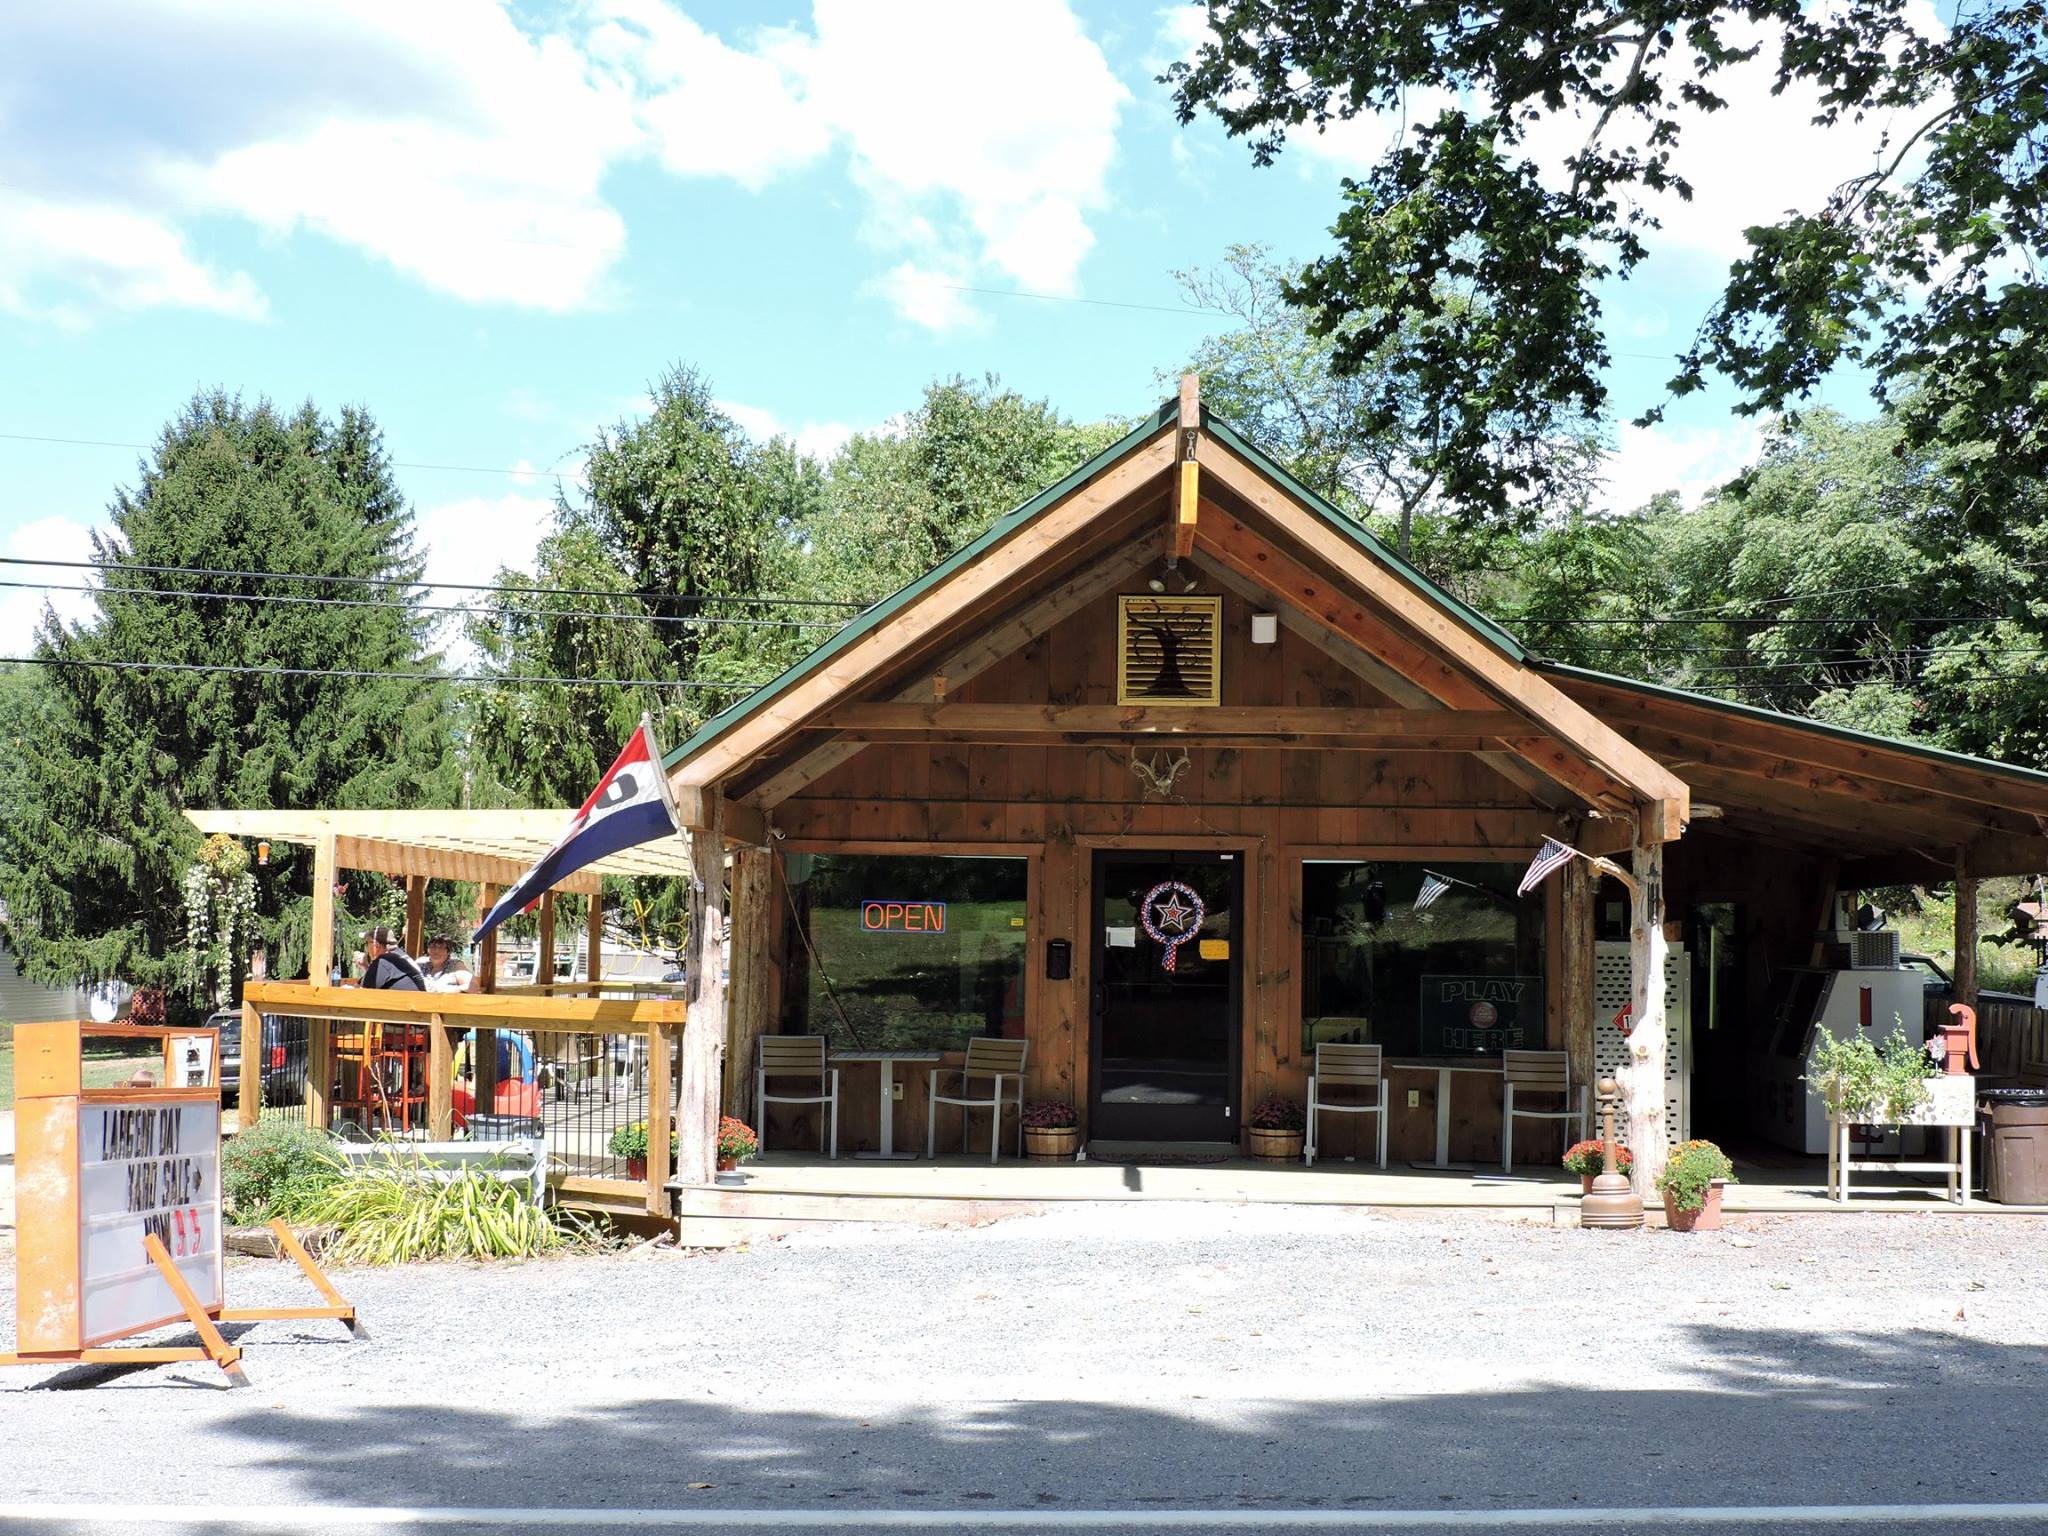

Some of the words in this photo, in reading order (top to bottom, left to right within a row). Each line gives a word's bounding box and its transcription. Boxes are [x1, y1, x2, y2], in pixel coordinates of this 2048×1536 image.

[865, 903, 942, 930] OPEN
[1441, 980, 1525, 1002] PLAY
[1443, 1027, 1524, 1050] HERE
[102, 1108, 156, 1161] LARGENT
[159, 1107, 182, 1156] DAY
[127, 1161, 158, 1213] YARD
[162, 1159, 191, 1207] SALE
